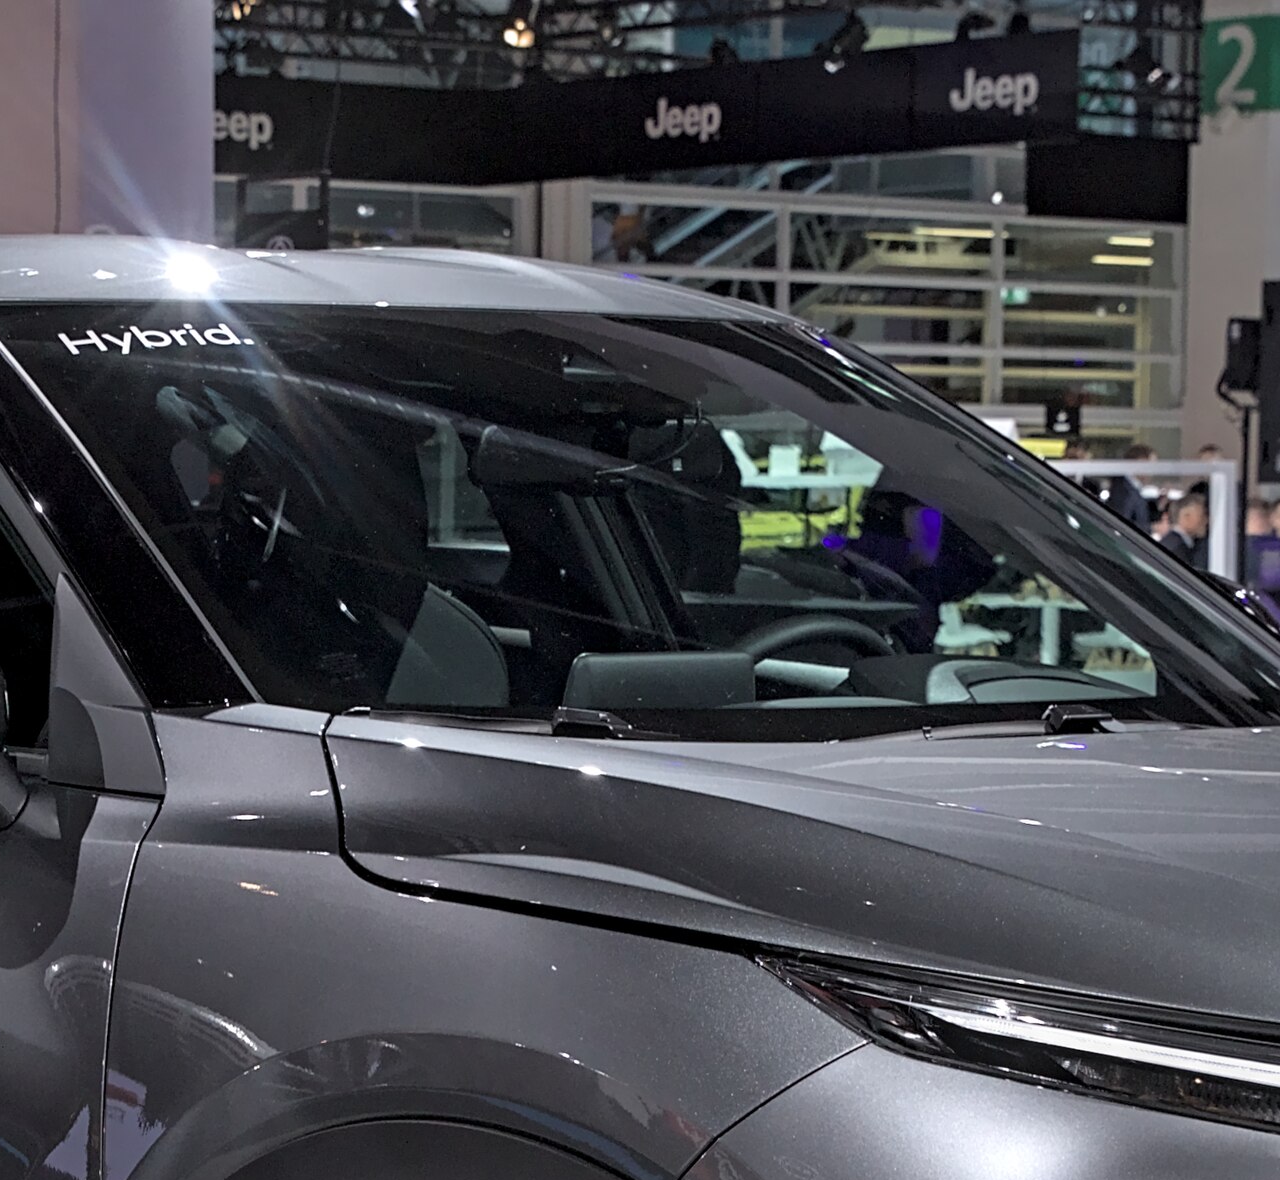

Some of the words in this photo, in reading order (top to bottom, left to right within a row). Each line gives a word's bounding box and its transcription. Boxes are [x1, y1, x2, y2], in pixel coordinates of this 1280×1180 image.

[949, 67, 1039, 116] Jeep
[213, 109, 273, 150] eep
[645, 98, 720, 142] Jeep
[58, 323, 255, 355] Hybrid.
